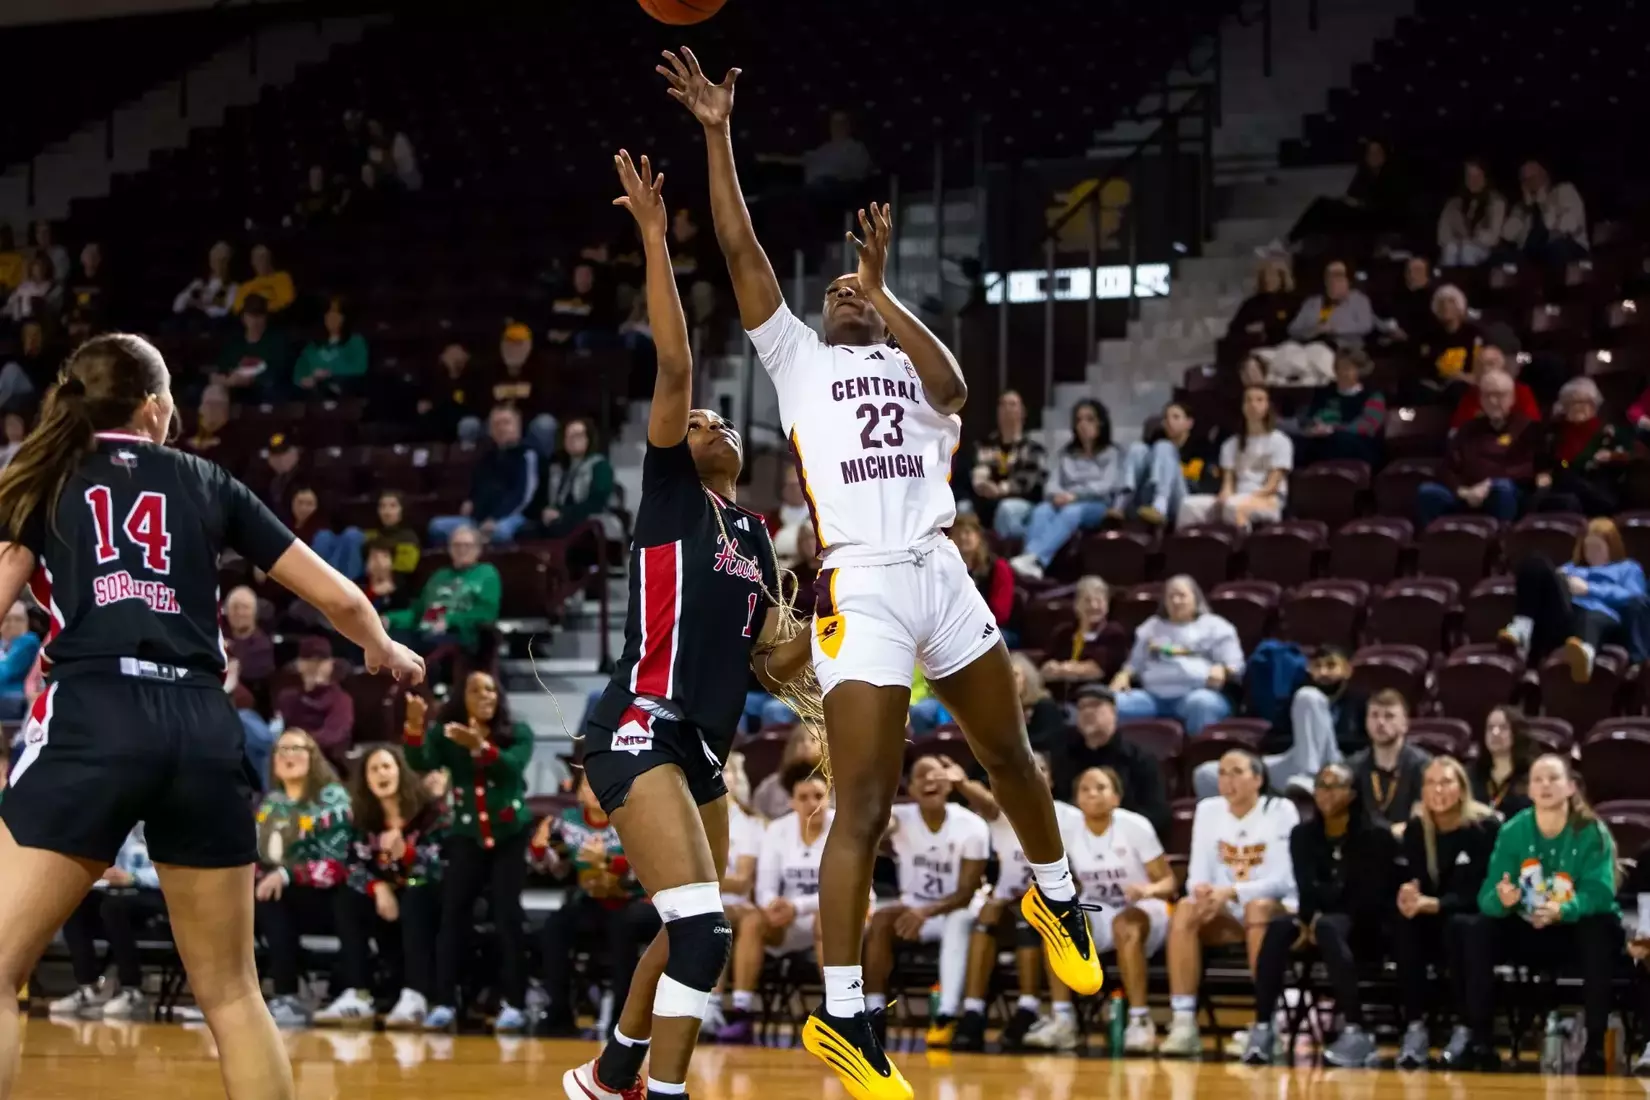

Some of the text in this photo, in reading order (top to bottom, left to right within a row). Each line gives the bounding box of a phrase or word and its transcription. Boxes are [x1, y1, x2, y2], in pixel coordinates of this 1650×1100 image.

[832, 377, 920, 404] CENTRAL
[856, 402, 904, 449] 23
[840, 454, 925, 484] MICHIGAN
[85, 484, 171, 575] 14
